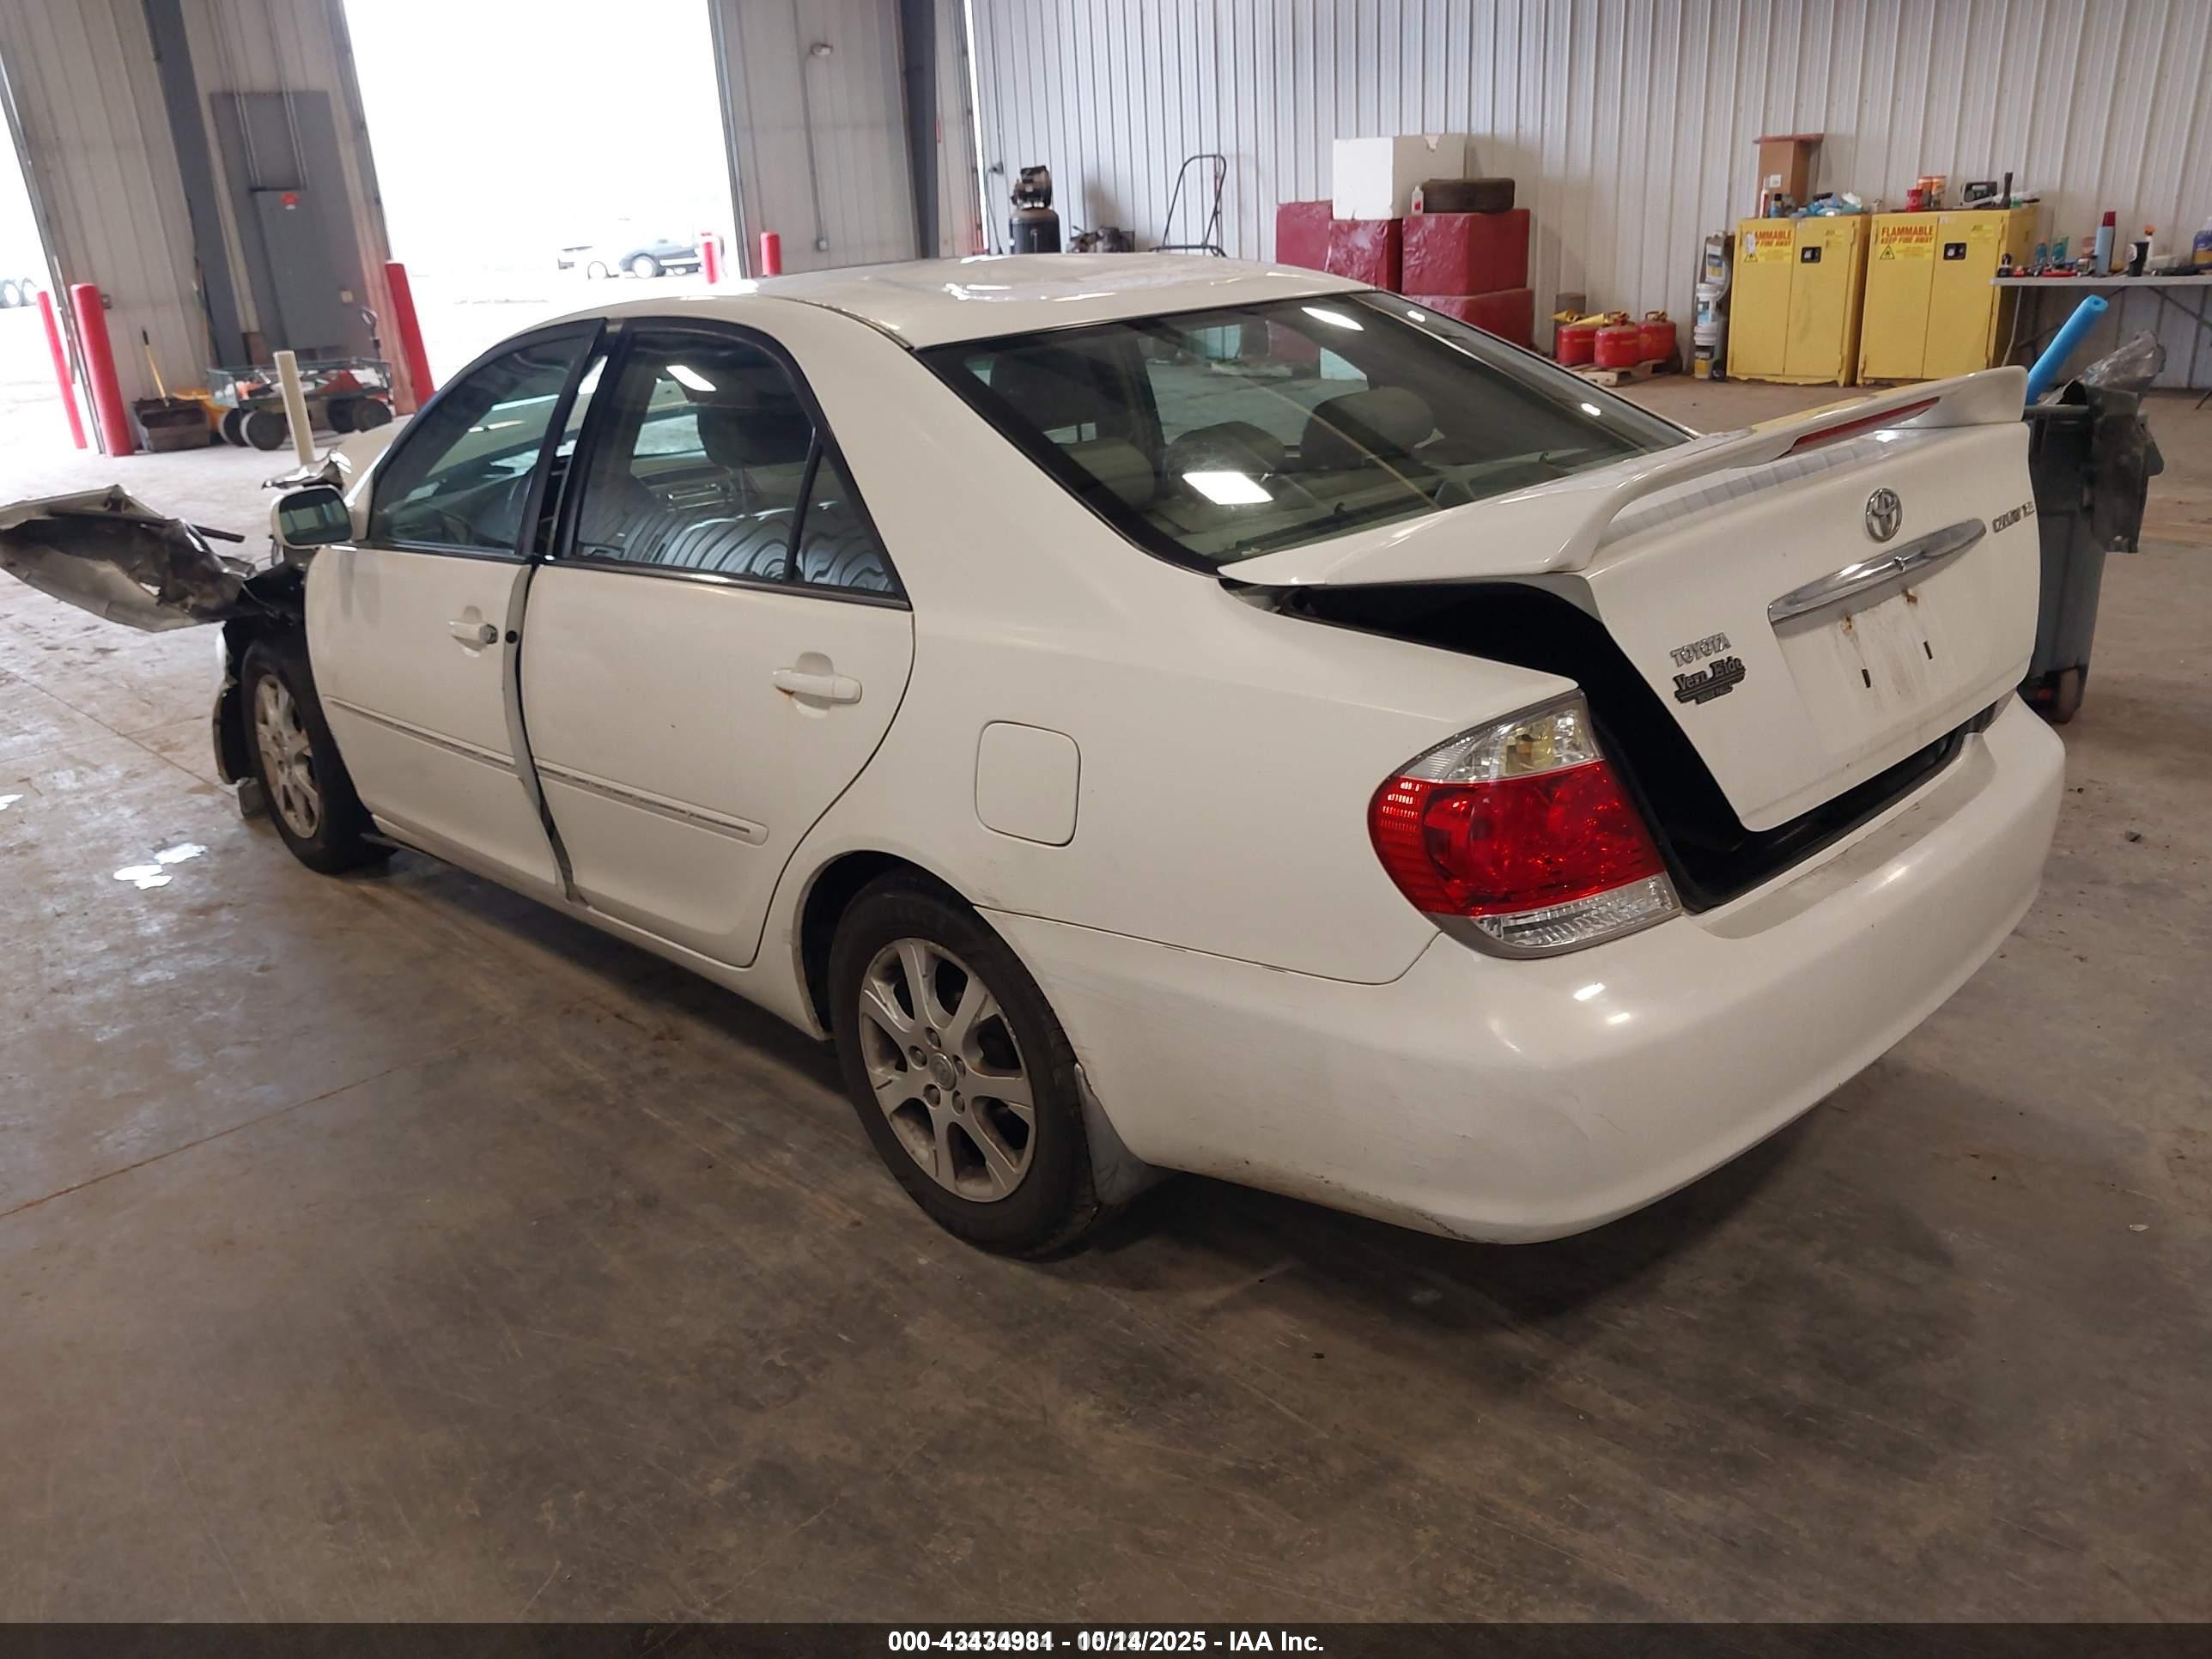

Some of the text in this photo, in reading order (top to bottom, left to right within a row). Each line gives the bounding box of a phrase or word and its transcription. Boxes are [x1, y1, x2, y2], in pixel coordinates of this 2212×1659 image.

[1746, 229, 1792, 240] AMMABLE
[1881, 226, 1934, 236] FLAMMABLE
[1670, 632, 1731, 667] TOYOTA
[1673, 671, 1707, 690] Vern
